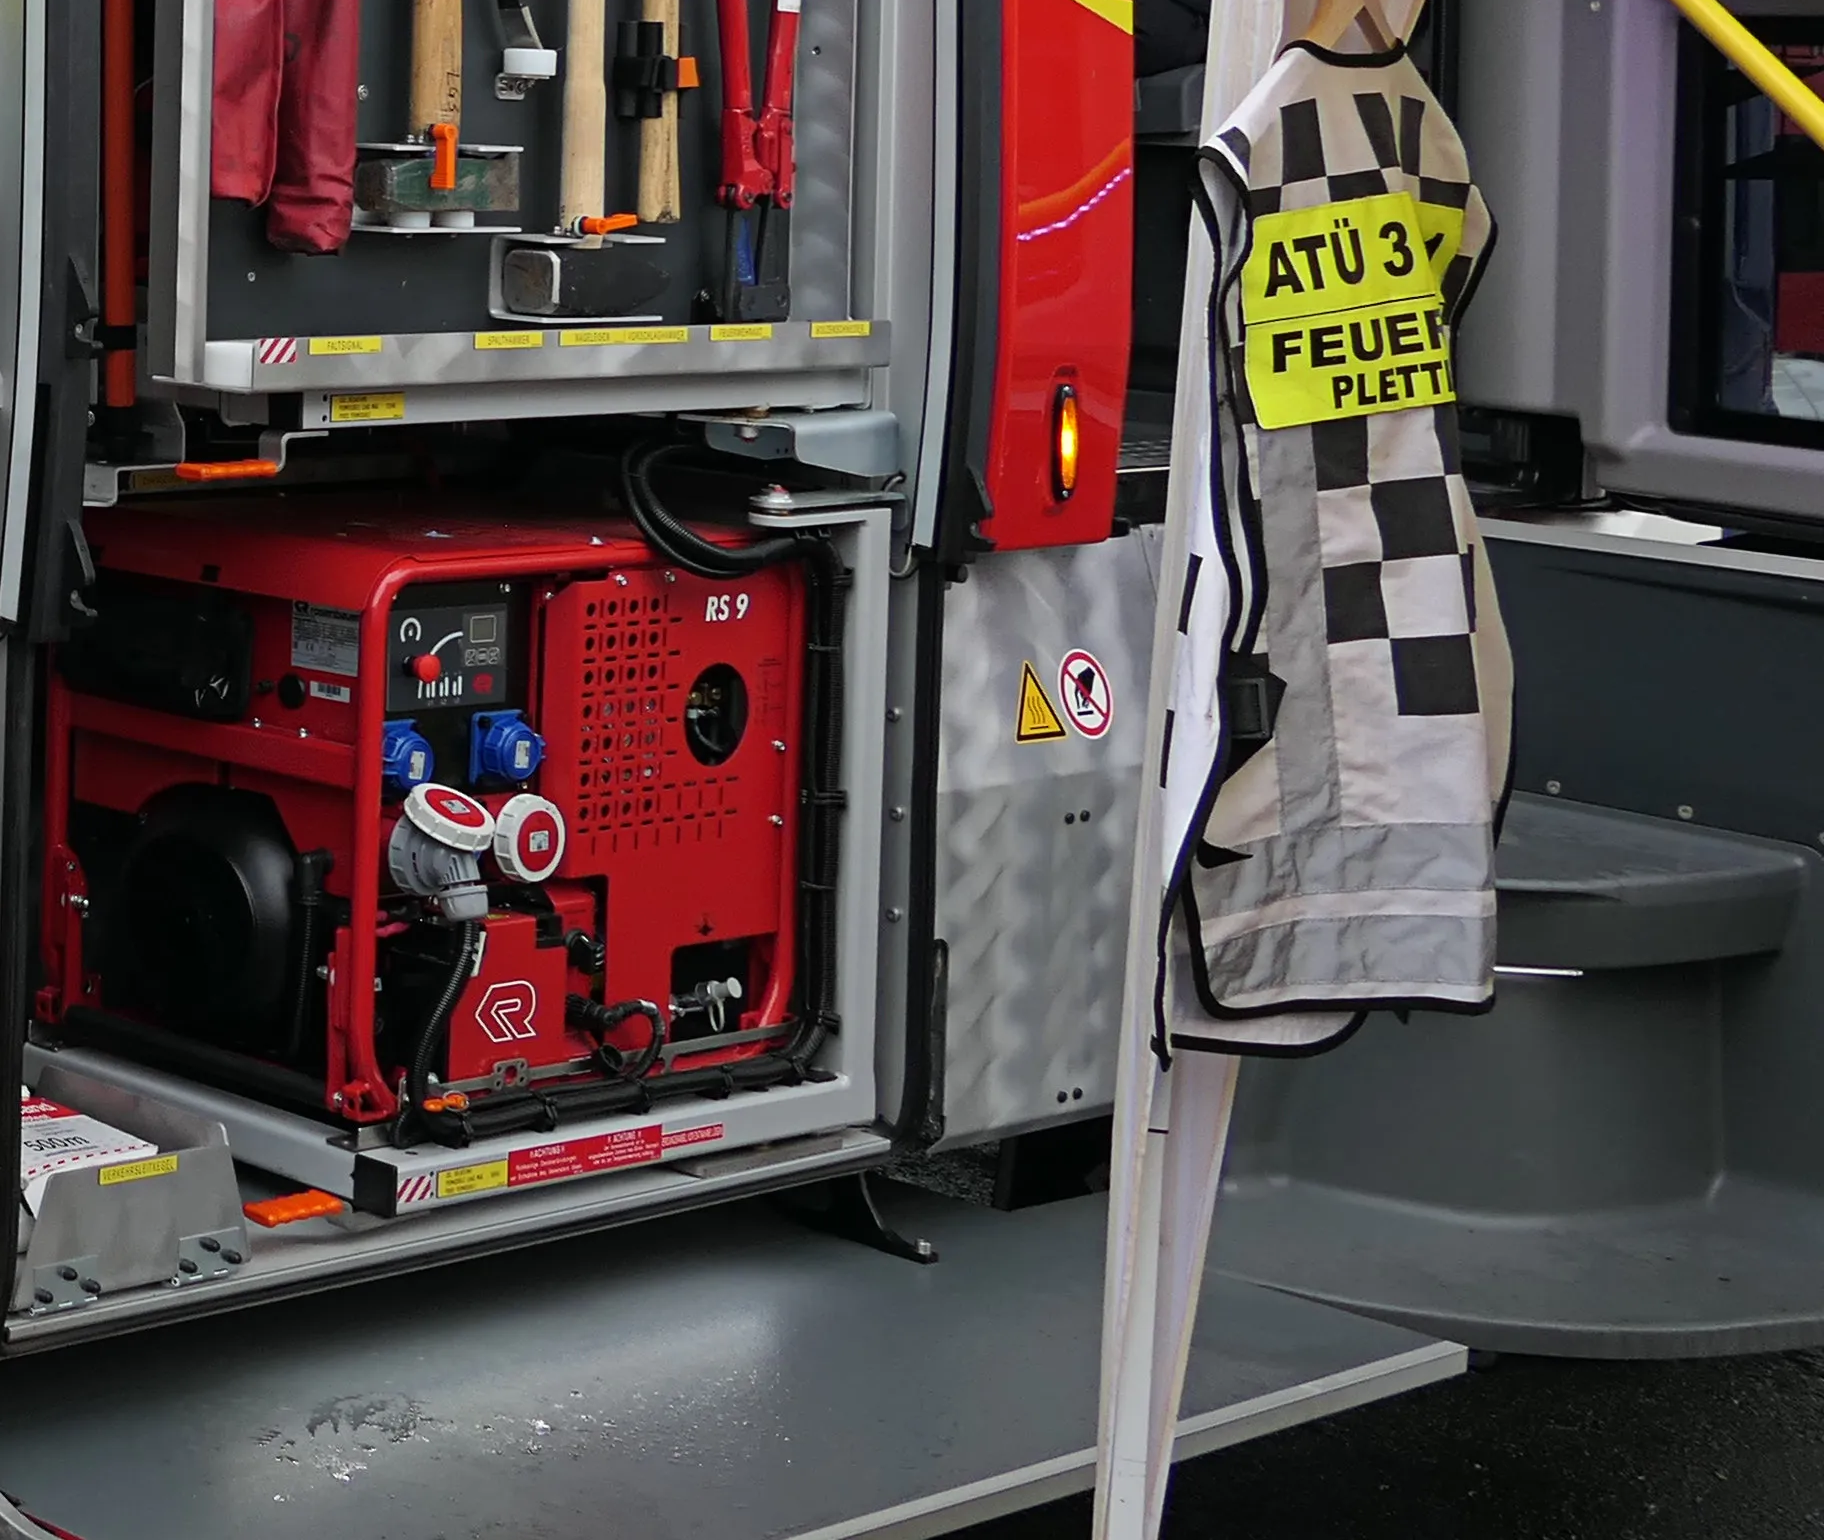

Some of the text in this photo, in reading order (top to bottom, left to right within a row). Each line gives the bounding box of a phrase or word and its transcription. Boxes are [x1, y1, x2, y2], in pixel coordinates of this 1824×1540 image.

[1264, 217, 1365, 298] ATÜ
[1379, 221, 1414, 277] 3
[705, 593, 749, 622] RS 9
